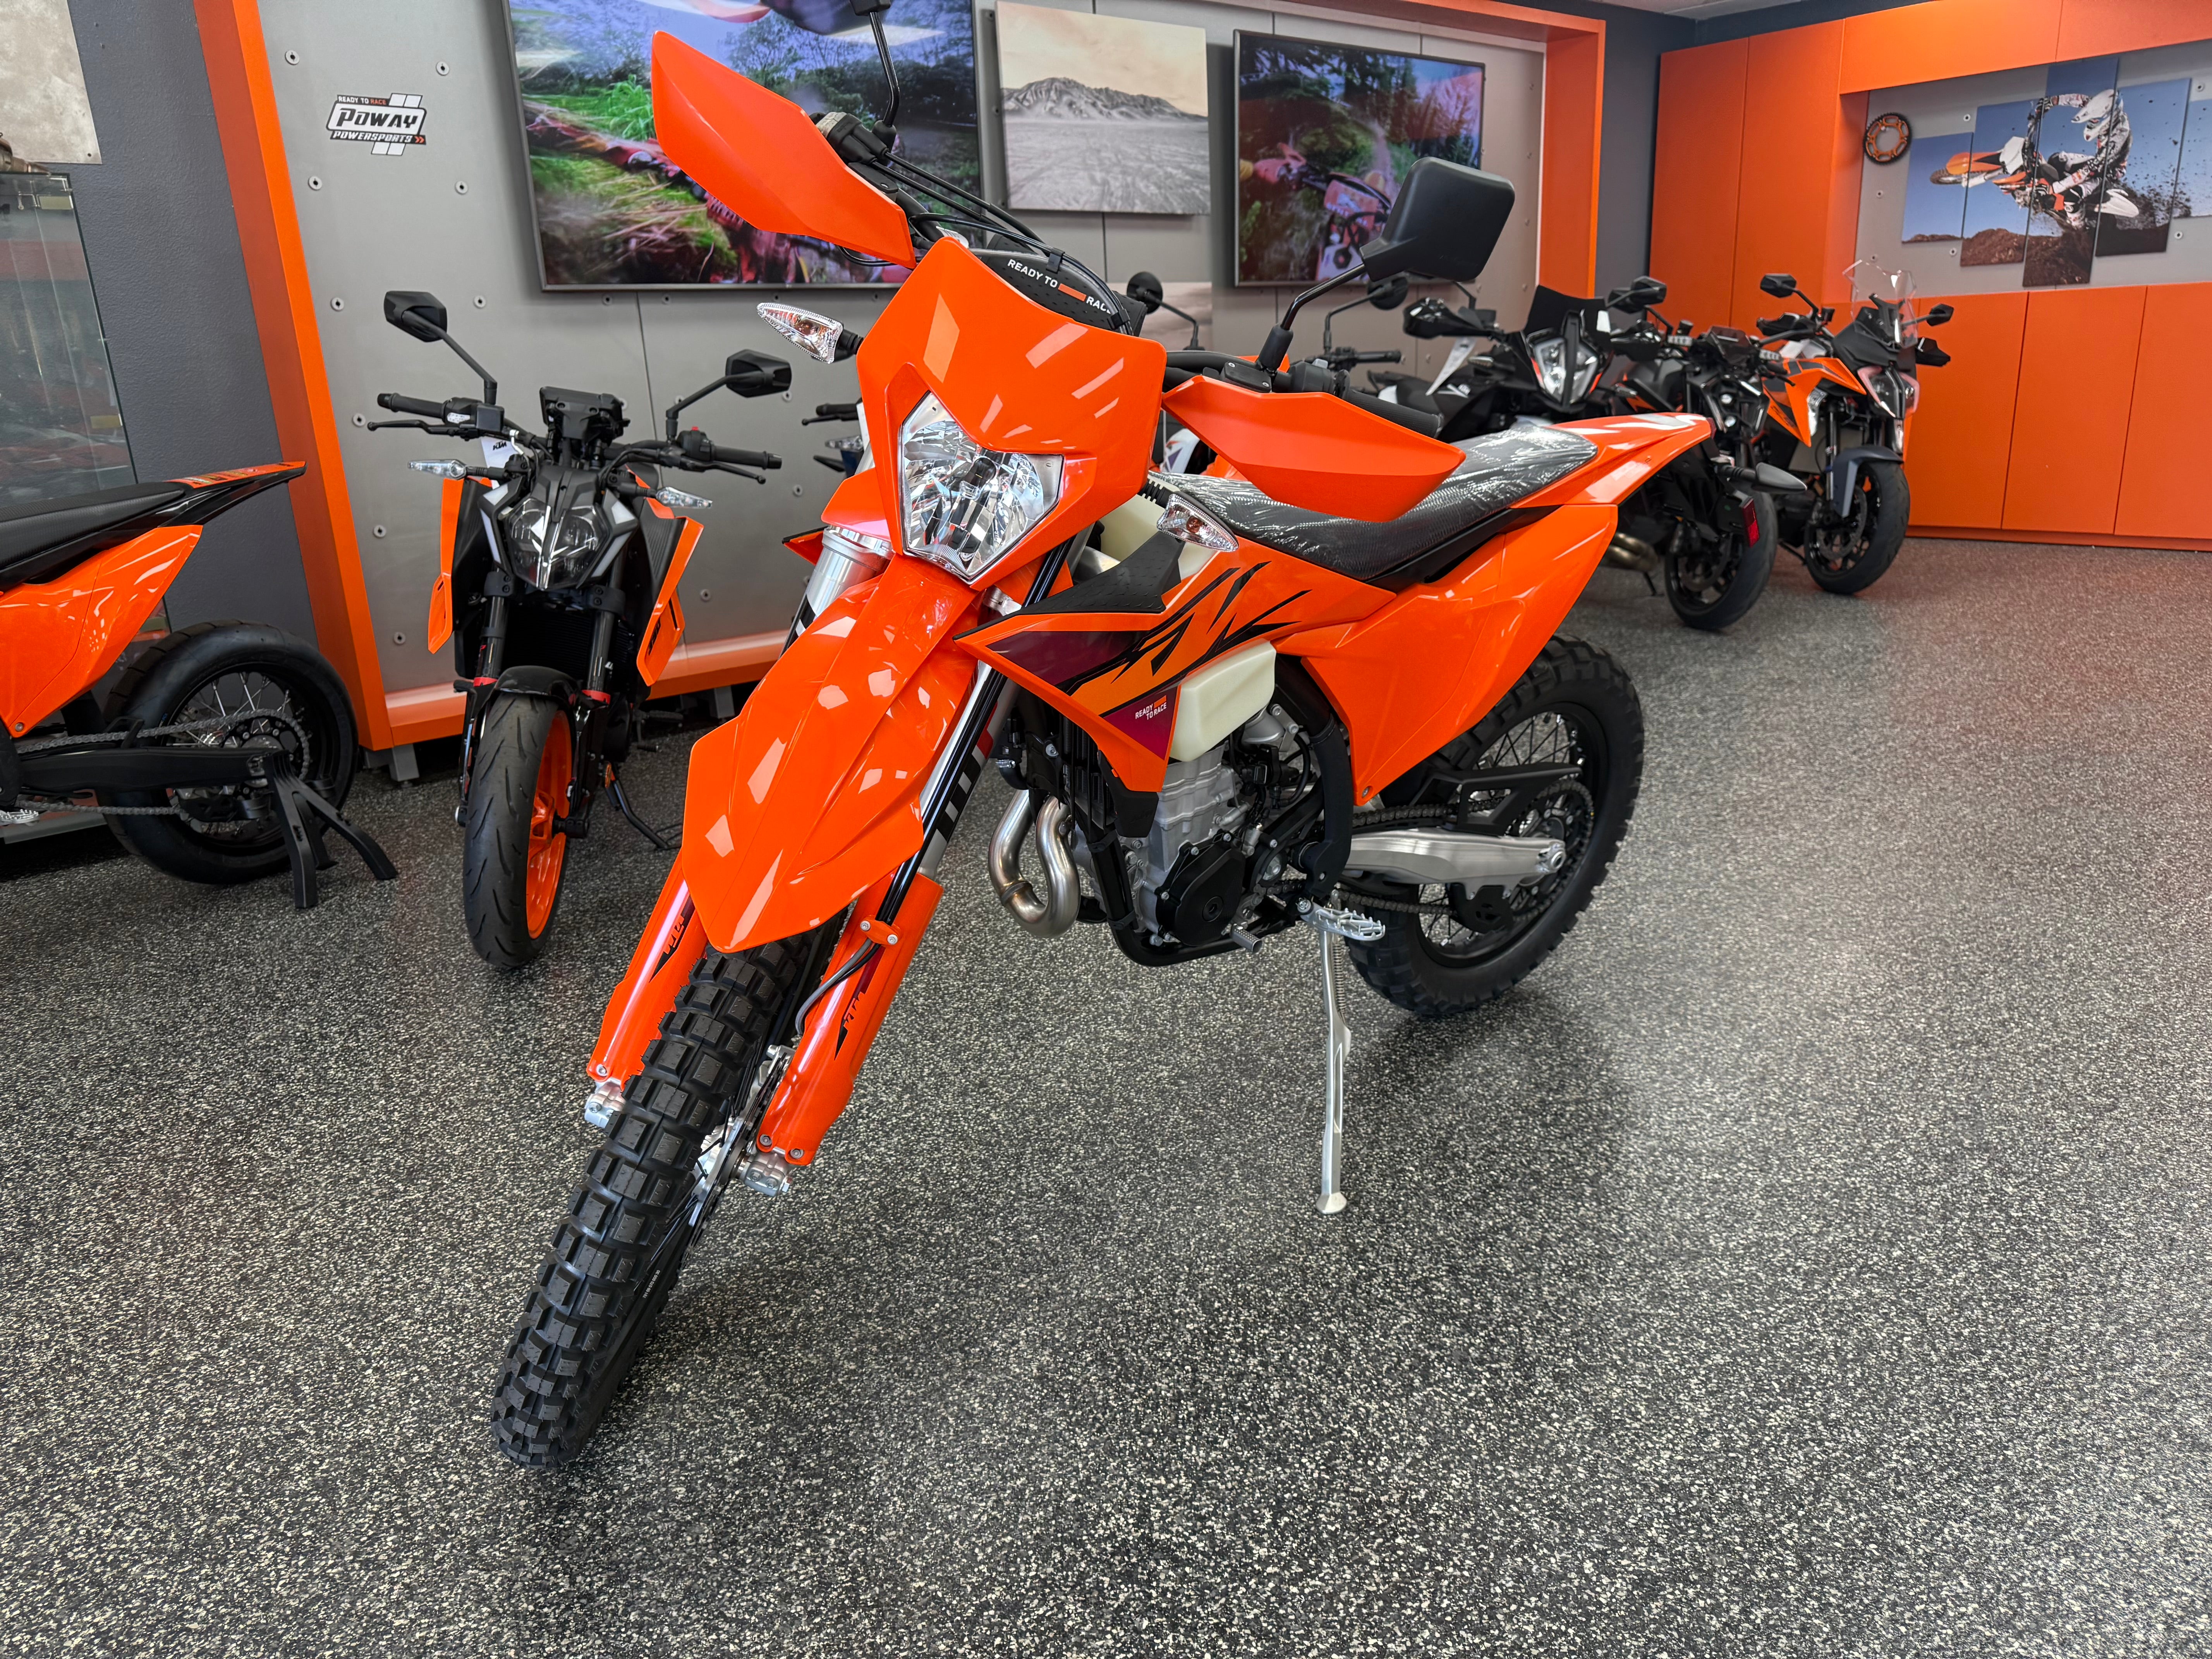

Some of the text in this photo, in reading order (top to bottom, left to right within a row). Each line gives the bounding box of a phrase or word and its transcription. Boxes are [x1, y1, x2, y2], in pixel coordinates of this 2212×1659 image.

[336, 108, 418, 128] POWAY
[333, 131, 413, 143] POWERSPORTS
[1007, 259, 1111, 314] READY TO RAC
[493, 441, 507, 450] KTM
[1135, 703, 1153, 720] READY
[1146, 702, 1167, 720] TO RACE
